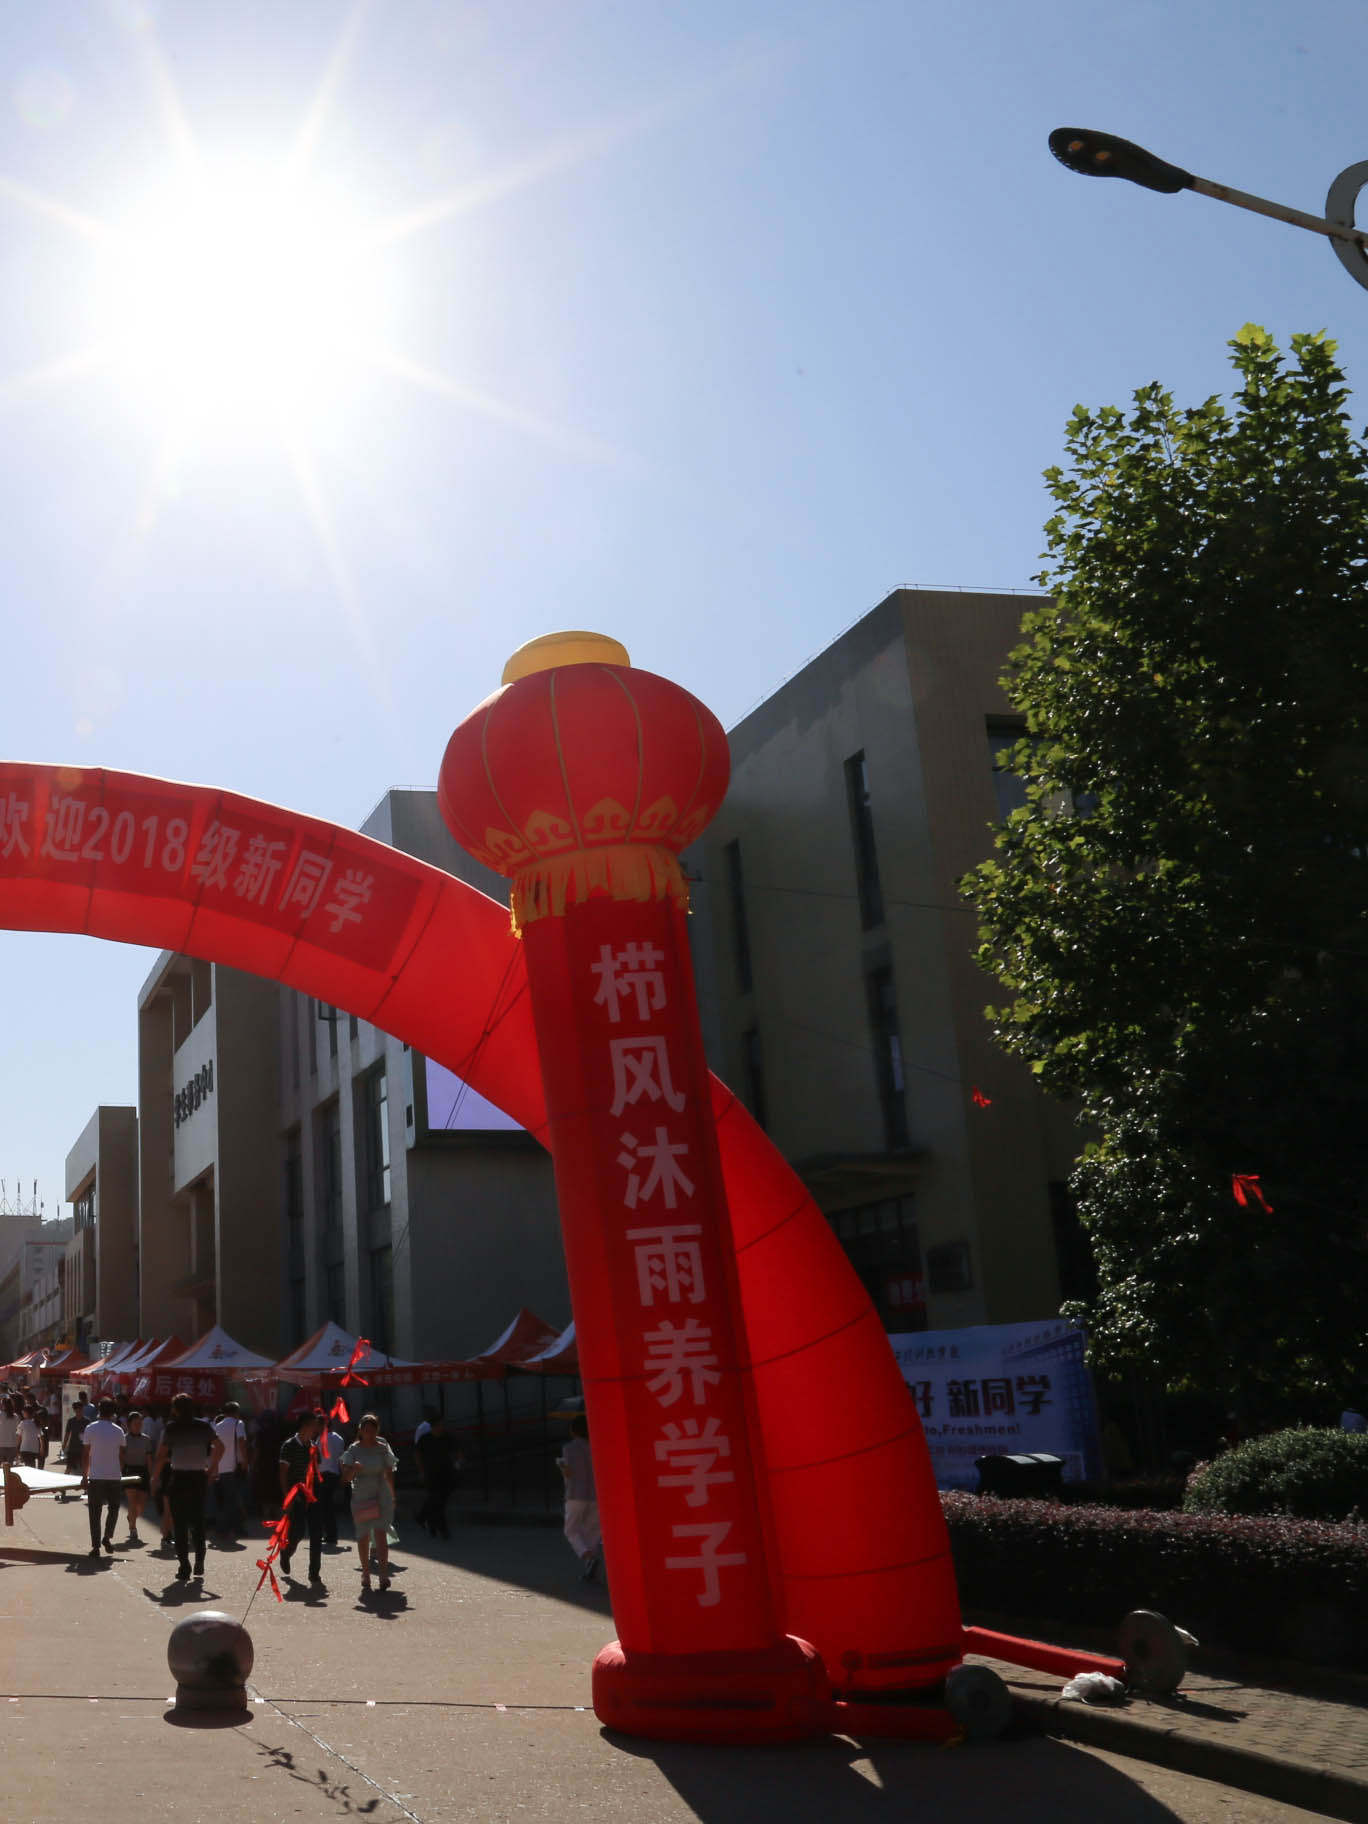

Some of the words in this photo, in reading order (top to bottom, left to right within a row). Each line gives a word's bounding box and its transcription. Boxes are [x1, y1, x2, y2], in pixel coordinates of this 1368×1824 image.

[590, 940, 747, 1607] 栉风沐雨养学子
[946, 1374, 1052, 1417] 新同学
